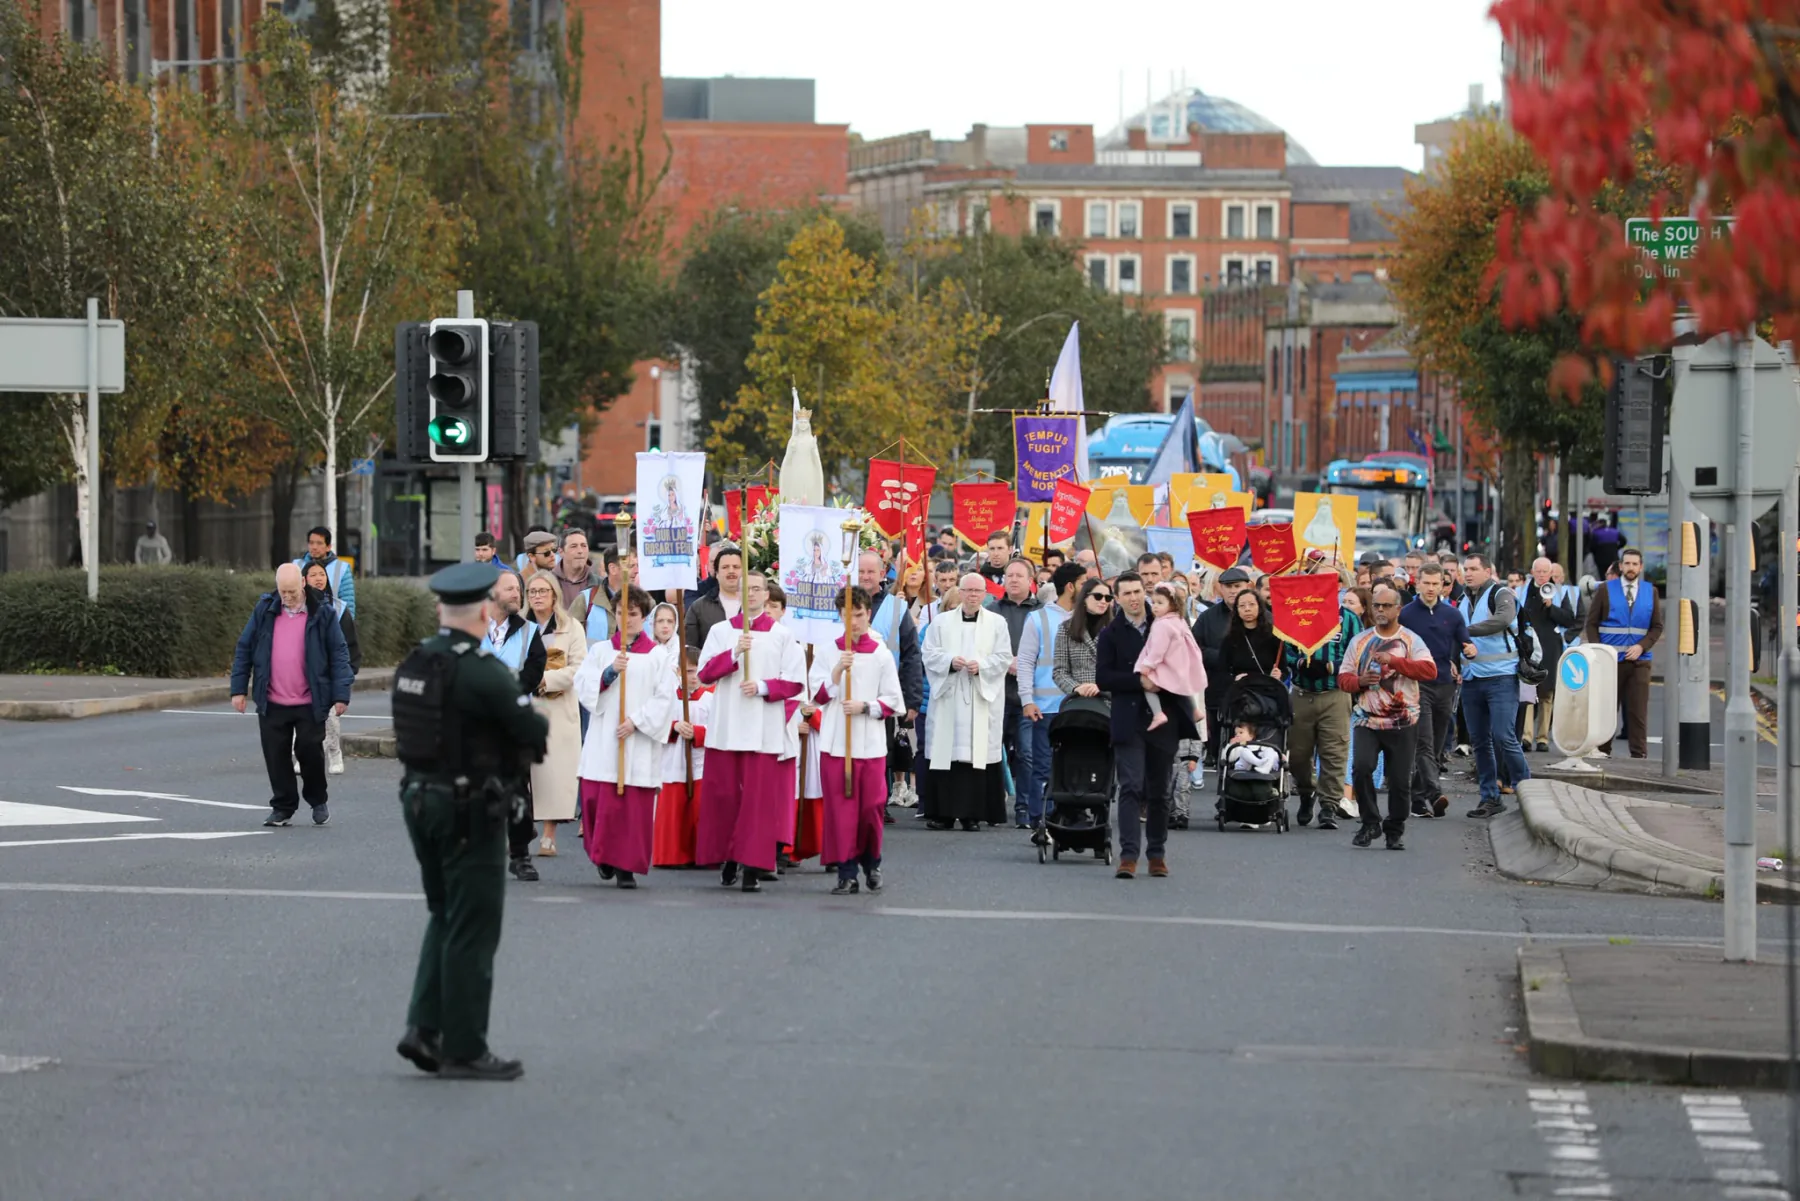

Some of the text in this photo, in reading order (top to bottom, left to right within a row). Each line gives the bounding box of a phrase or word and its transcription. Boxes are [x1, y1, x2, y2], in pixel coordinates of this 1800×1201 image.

[1633, 228, 1659, 241] The
[1633, 245, 1701, 260] The WES
[1024, 430, 1069, 446] TEMPUS
[1028, 443, 1062, 454] FUGIT
[1022, 460, 1070, 481] MEMENTO
[655, 529, 671, 541] OUR
[644, 542, 674, 555] ROSARY
[798, 582, 840, 597] OUR LADY'S
[397, 676, 425, 695] POLICE
